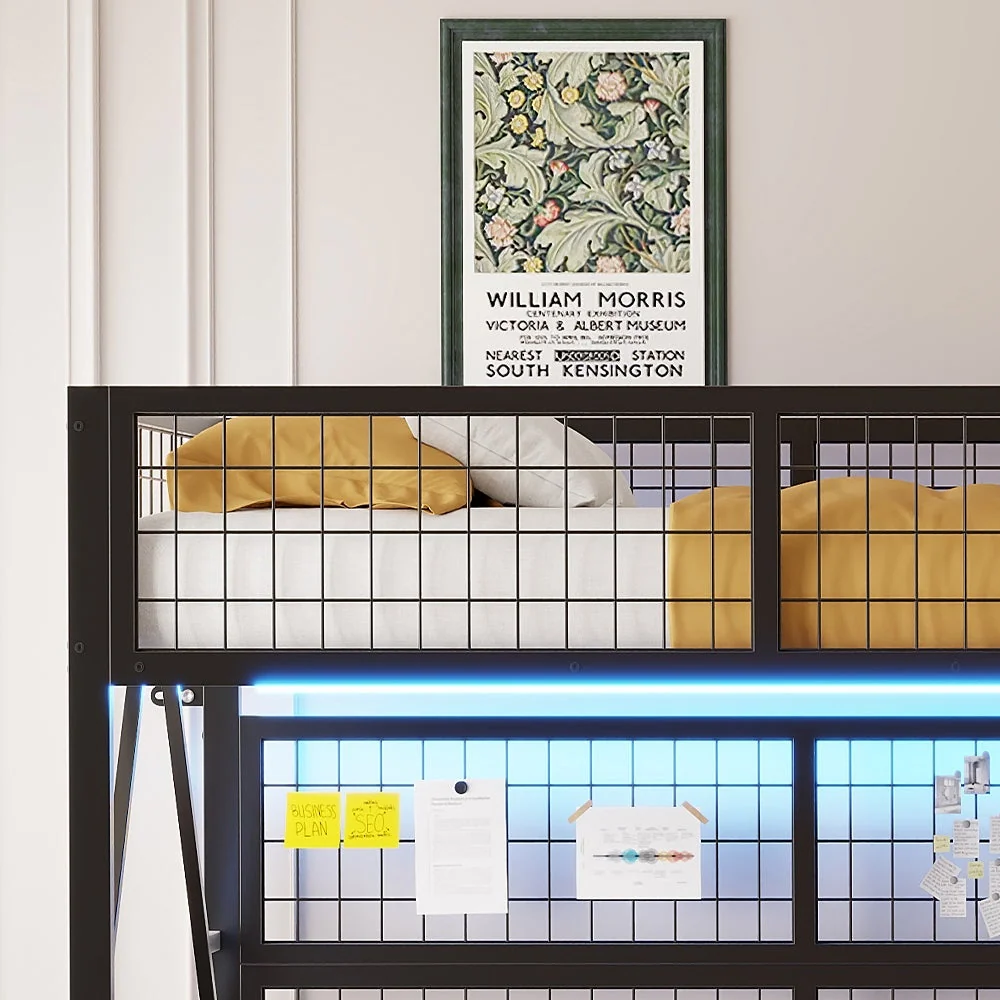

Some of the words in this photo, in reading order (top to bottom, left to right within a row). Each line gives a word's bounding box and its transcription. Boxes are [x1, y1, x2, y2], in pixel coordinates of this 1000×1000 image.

[486, 291, 582, 308] WILLIAM
[598, 291, 686, 308] MORRIS
[526, 310, 582, 318] CENTENARY
[587, 310, 641, 318] EXHIBITION
[486, 320, 550, 331] VICTORIA
[556, 320, 565, 331] &
[573, 320, 623, 331] ALBERT
[627, 320, 686, 331] MUSEUM
[486, 349, 543, 361] NEAREST
[632, 349, 685, 361] STATION
[486, 363, 549, 378] SOUTH
[562, 363, 683, 378] KENSINGTON
[290, 803, 337, 820] BUSINESS
[295, 820, 328, 838] PLAN
[355, 812, 385, 834] SEO
